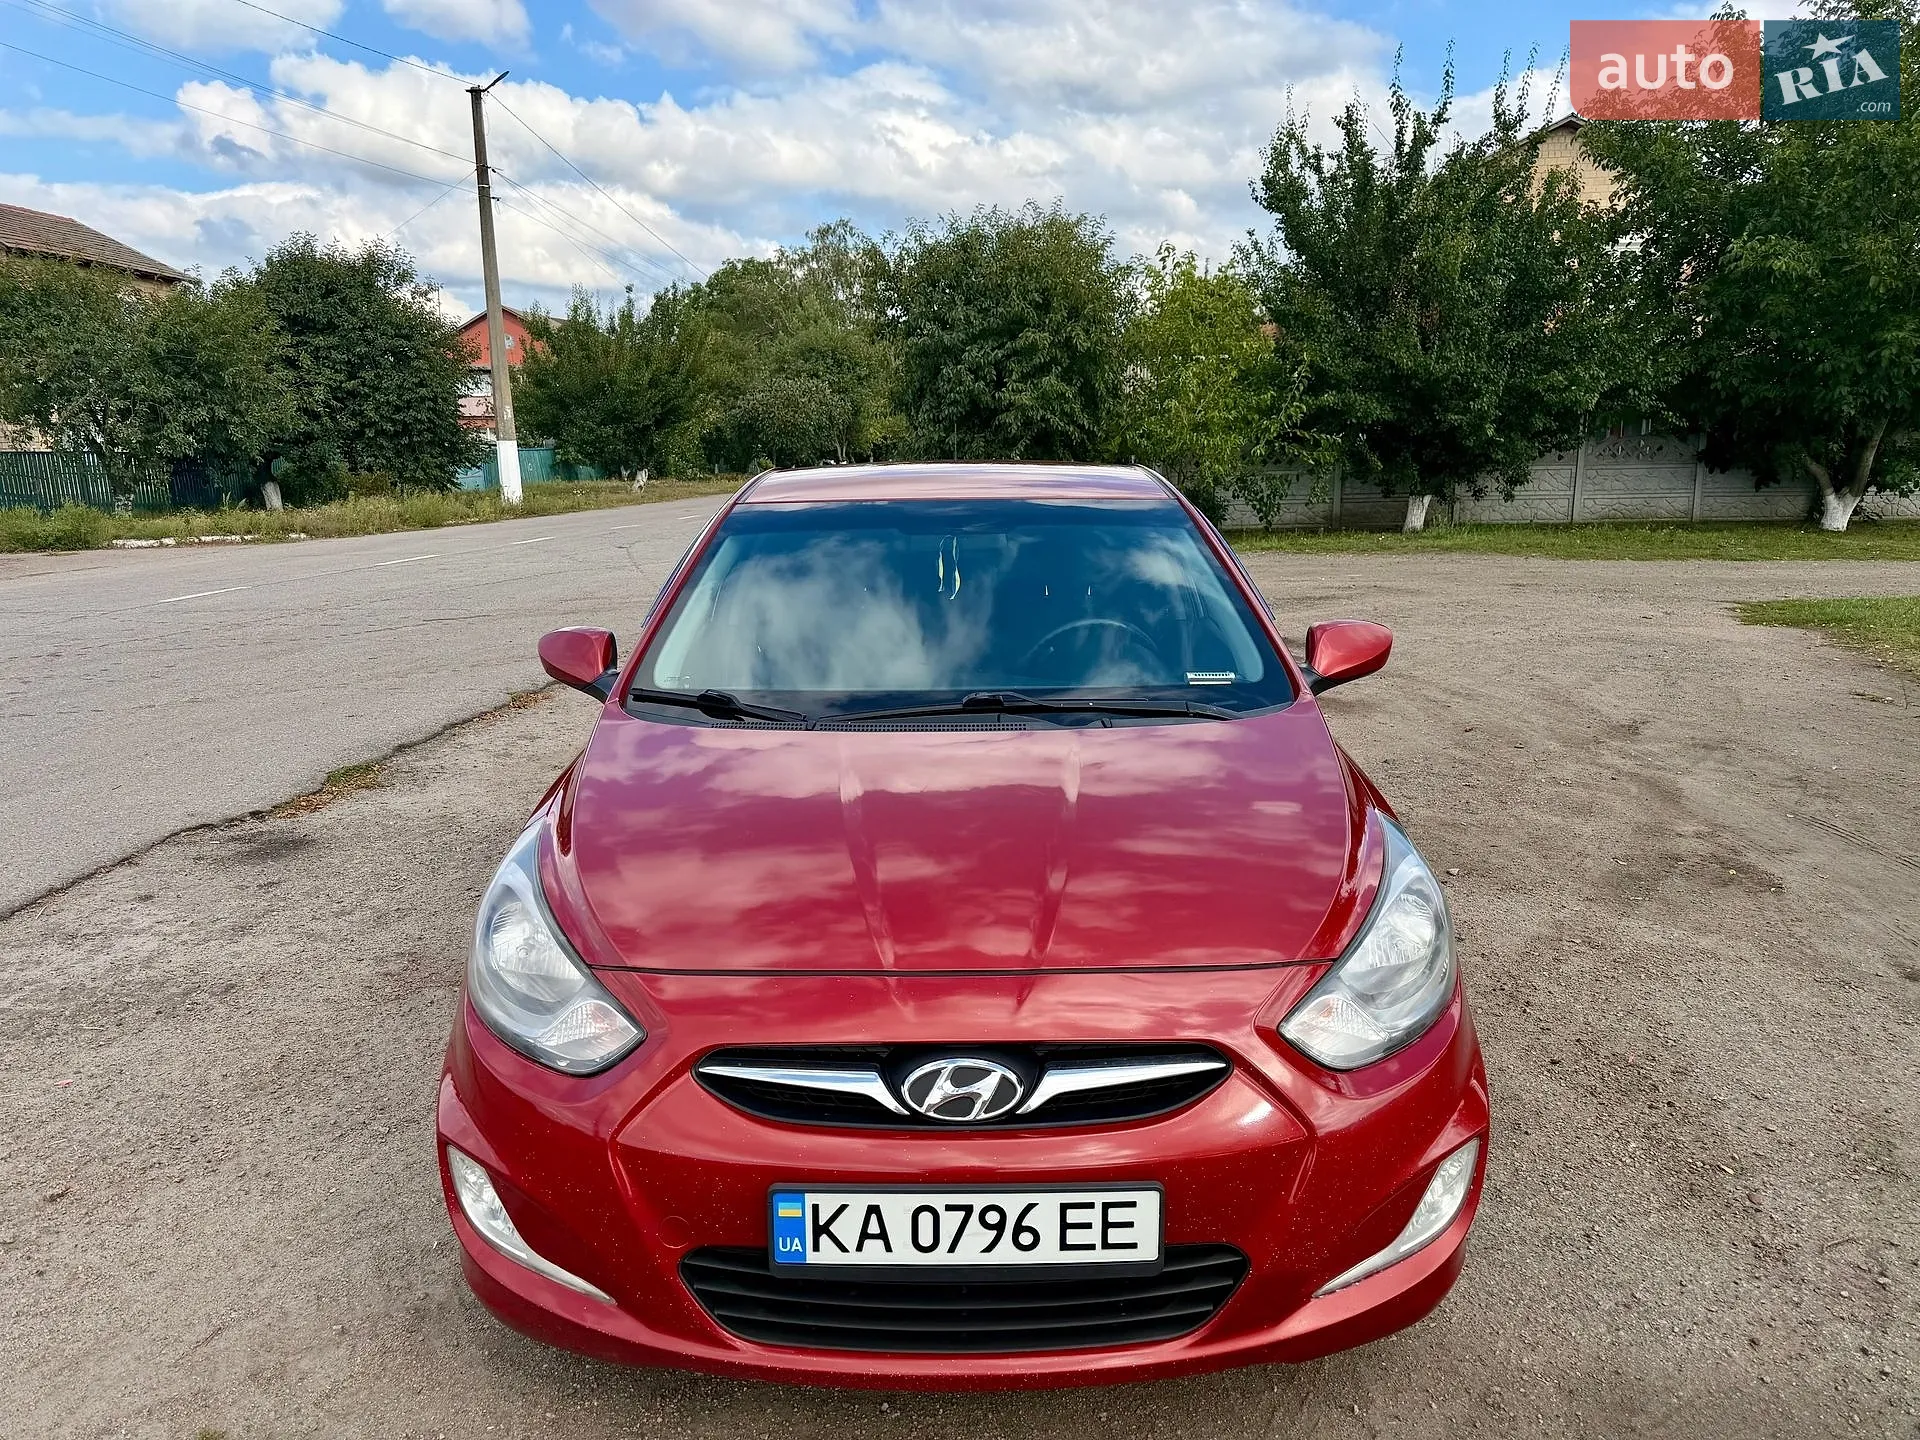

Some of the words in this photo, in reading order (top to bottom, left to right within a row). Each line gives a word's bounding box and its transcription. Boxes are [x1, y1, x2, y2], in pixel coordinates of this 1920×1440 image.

[811, 1203, 893, 1253] KA
[910, 1202, 1041, 1254] 0796
[1059, 1200, 1138, 1252] EE
[779, 1237, 803, 1252] UA
